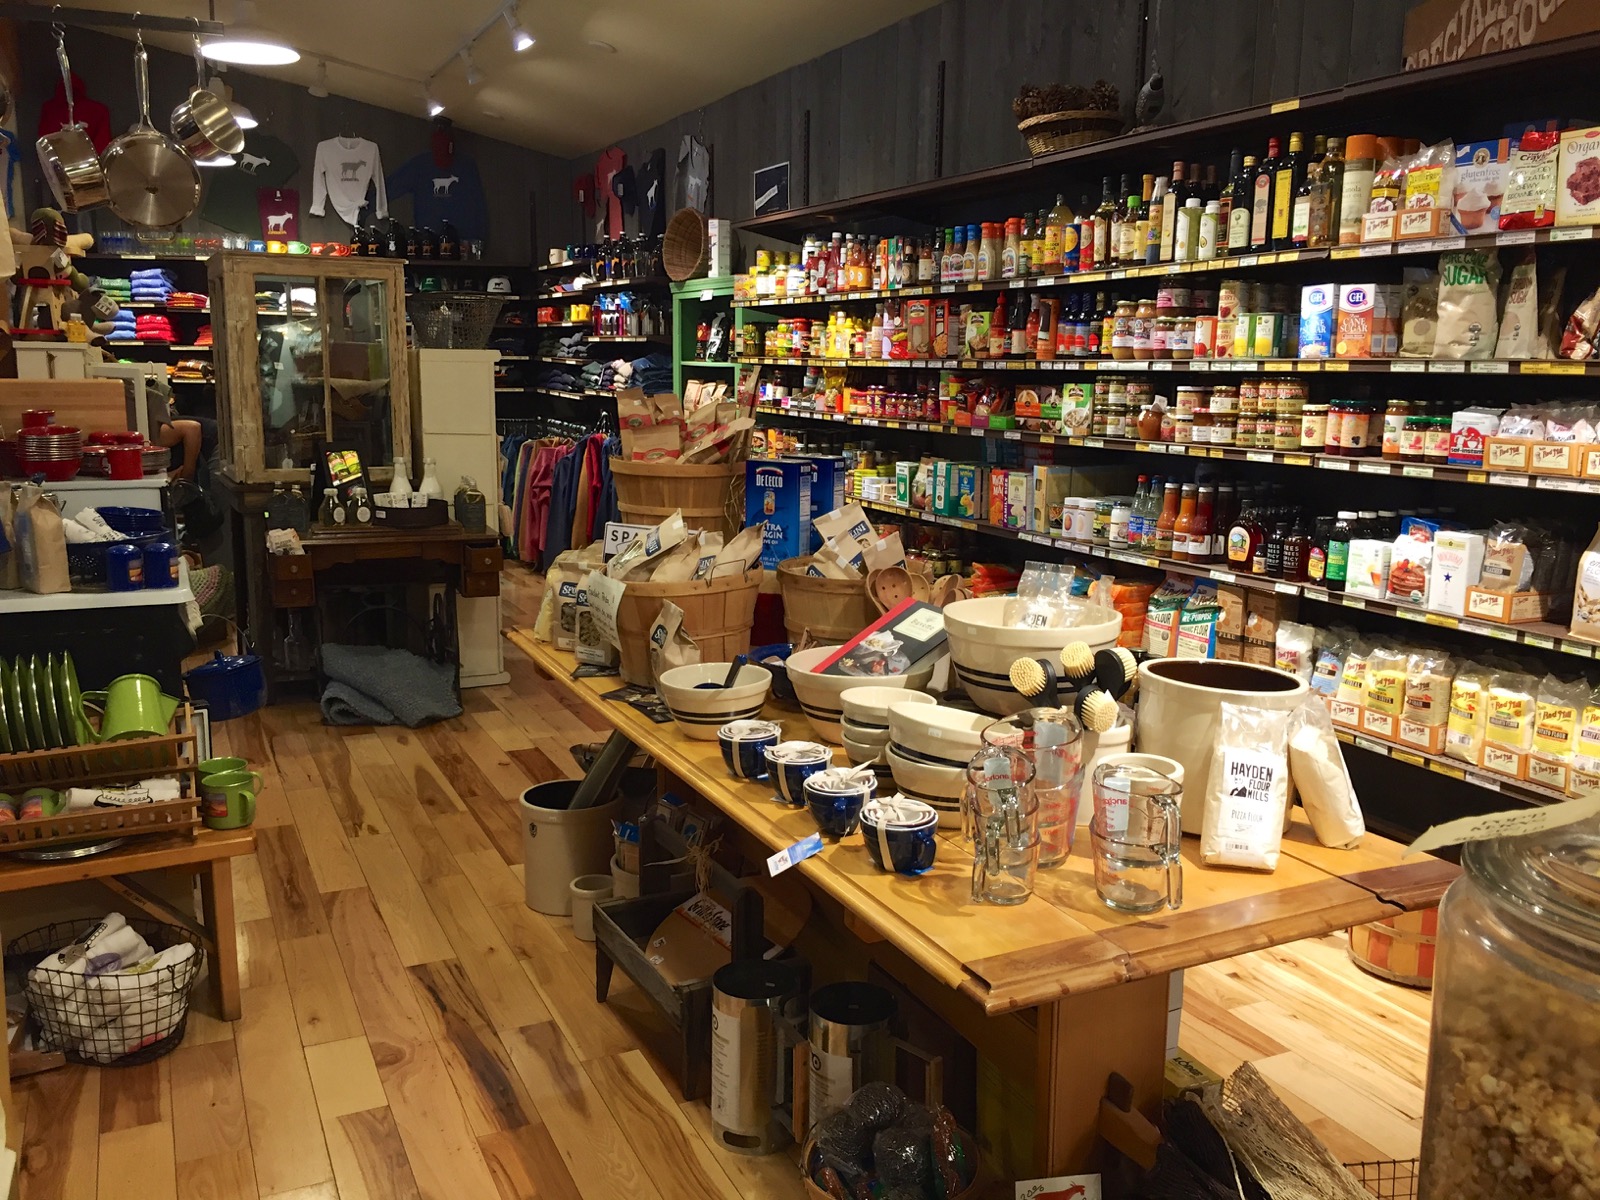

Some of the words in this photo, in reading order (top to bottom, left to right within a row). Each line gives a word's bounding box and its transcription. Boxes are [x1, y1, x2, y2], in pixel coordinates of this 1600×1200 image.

[1342, 317, 1366, 326] CANE
[765, 475, 783, 488] CECCO
[1155, 613, 1171, 624] FLOUR
[1193, 625, 1208, 636] FLOUR
[1495, 701, 1508, 709] Red
[1509, 701, 1521, 710] Mill
[1543, 711, 1557, 719] Red
[1558, 710, 1571, 720] Mill
[1231, 762, 1273, 782] HAYDEN
[1249, 779, 1270, 792] FLOUR
[1248, 791, 1269, 802] MILLS
[1231, 809, 1246, 820] PIZZA
